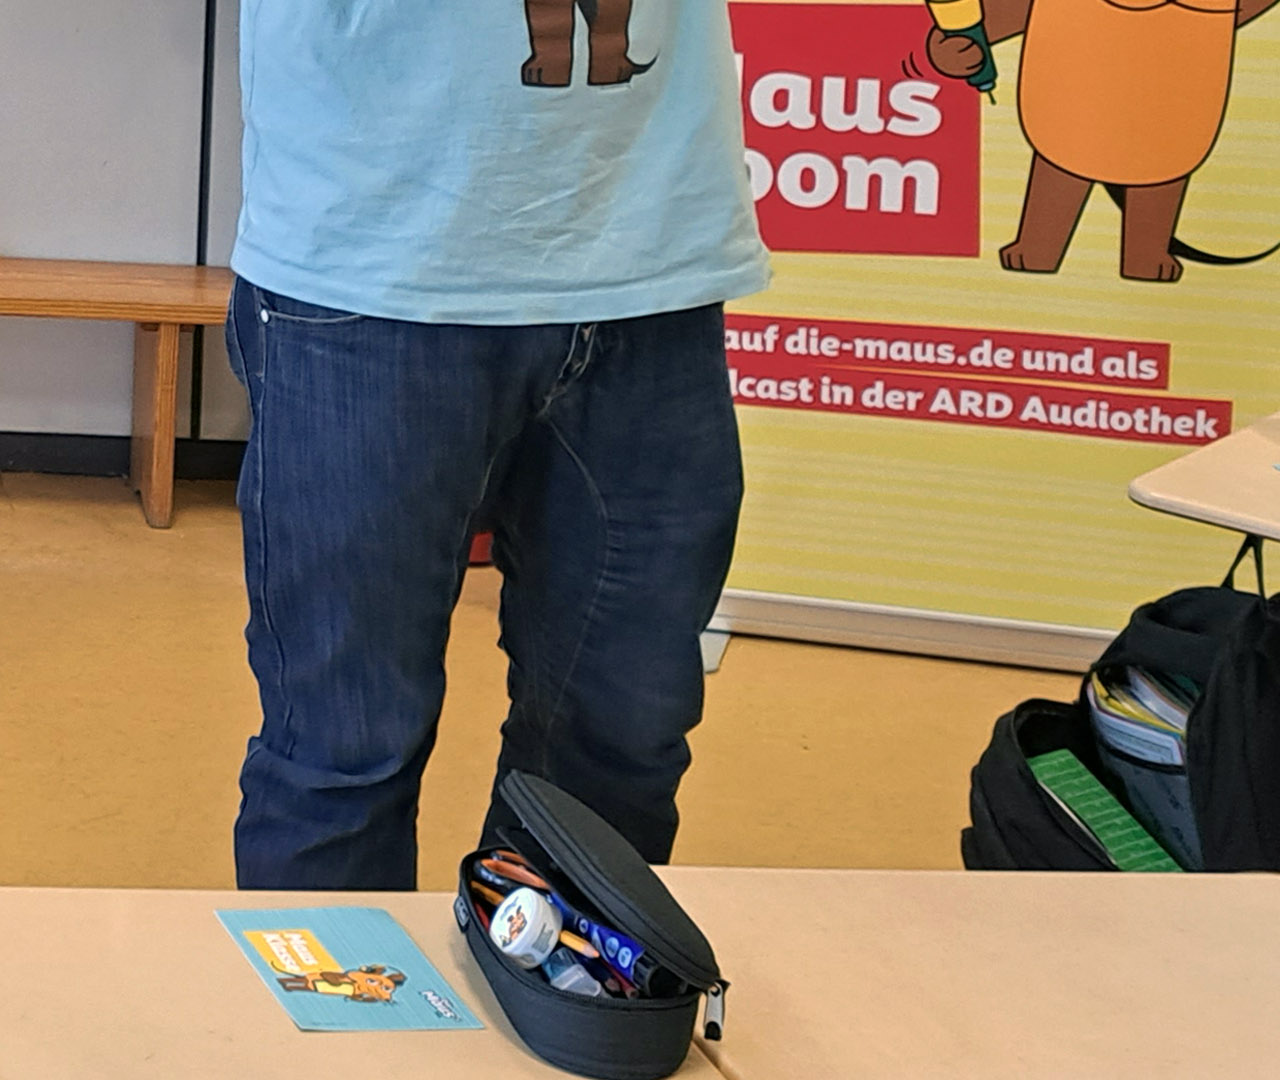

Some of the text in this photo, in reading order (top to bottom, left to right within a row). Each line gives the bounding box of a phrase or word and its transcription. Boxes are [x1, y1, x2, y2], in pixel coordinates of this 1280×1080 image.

[736, 53, 942, 137] aus
[784, 326, 1015, 371] die-maus.de
[1021, 344, 1096, 377] und
[1101, 348, 1159, 382] als
[820, 376, 854, 405] in
[861, 380, 924, 412] der
[929, 387, 1013, 420] ARD
[1020, 395, 1218, 439] Audiothek
